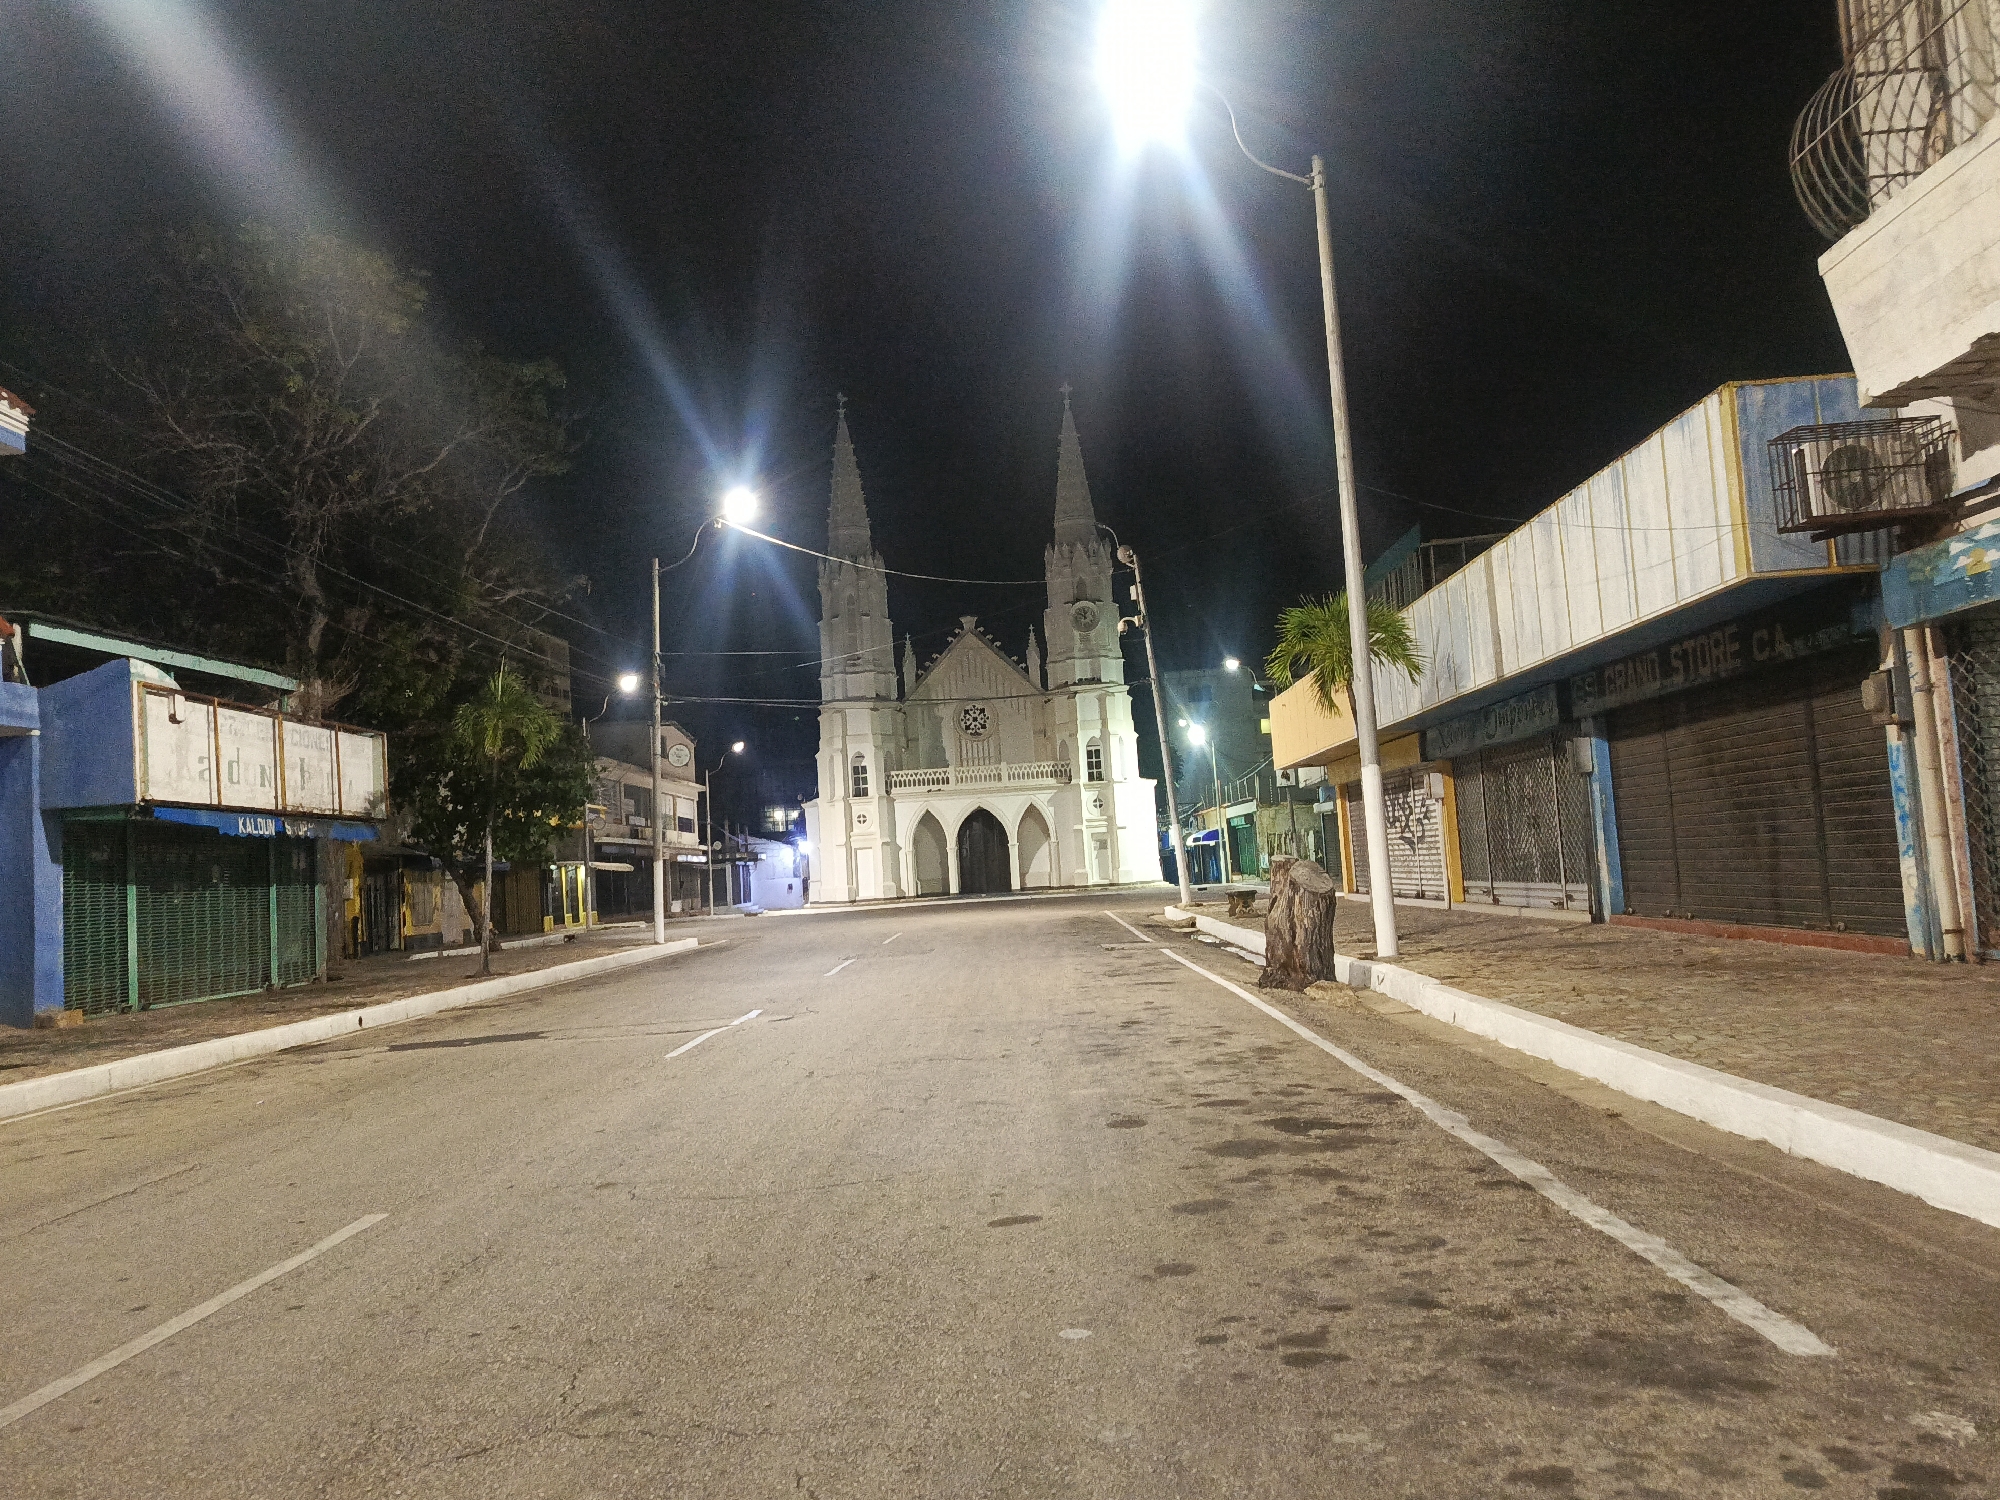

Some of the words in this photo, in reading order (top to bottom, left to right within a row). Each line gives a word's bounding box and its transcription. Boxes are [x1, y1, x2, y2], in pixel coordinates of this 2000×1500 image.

[1604, 652, 1661, 697] GRAND
[1670, 623, 1741, 684] STORE
[238, 817, 275, 835] KALOUN
